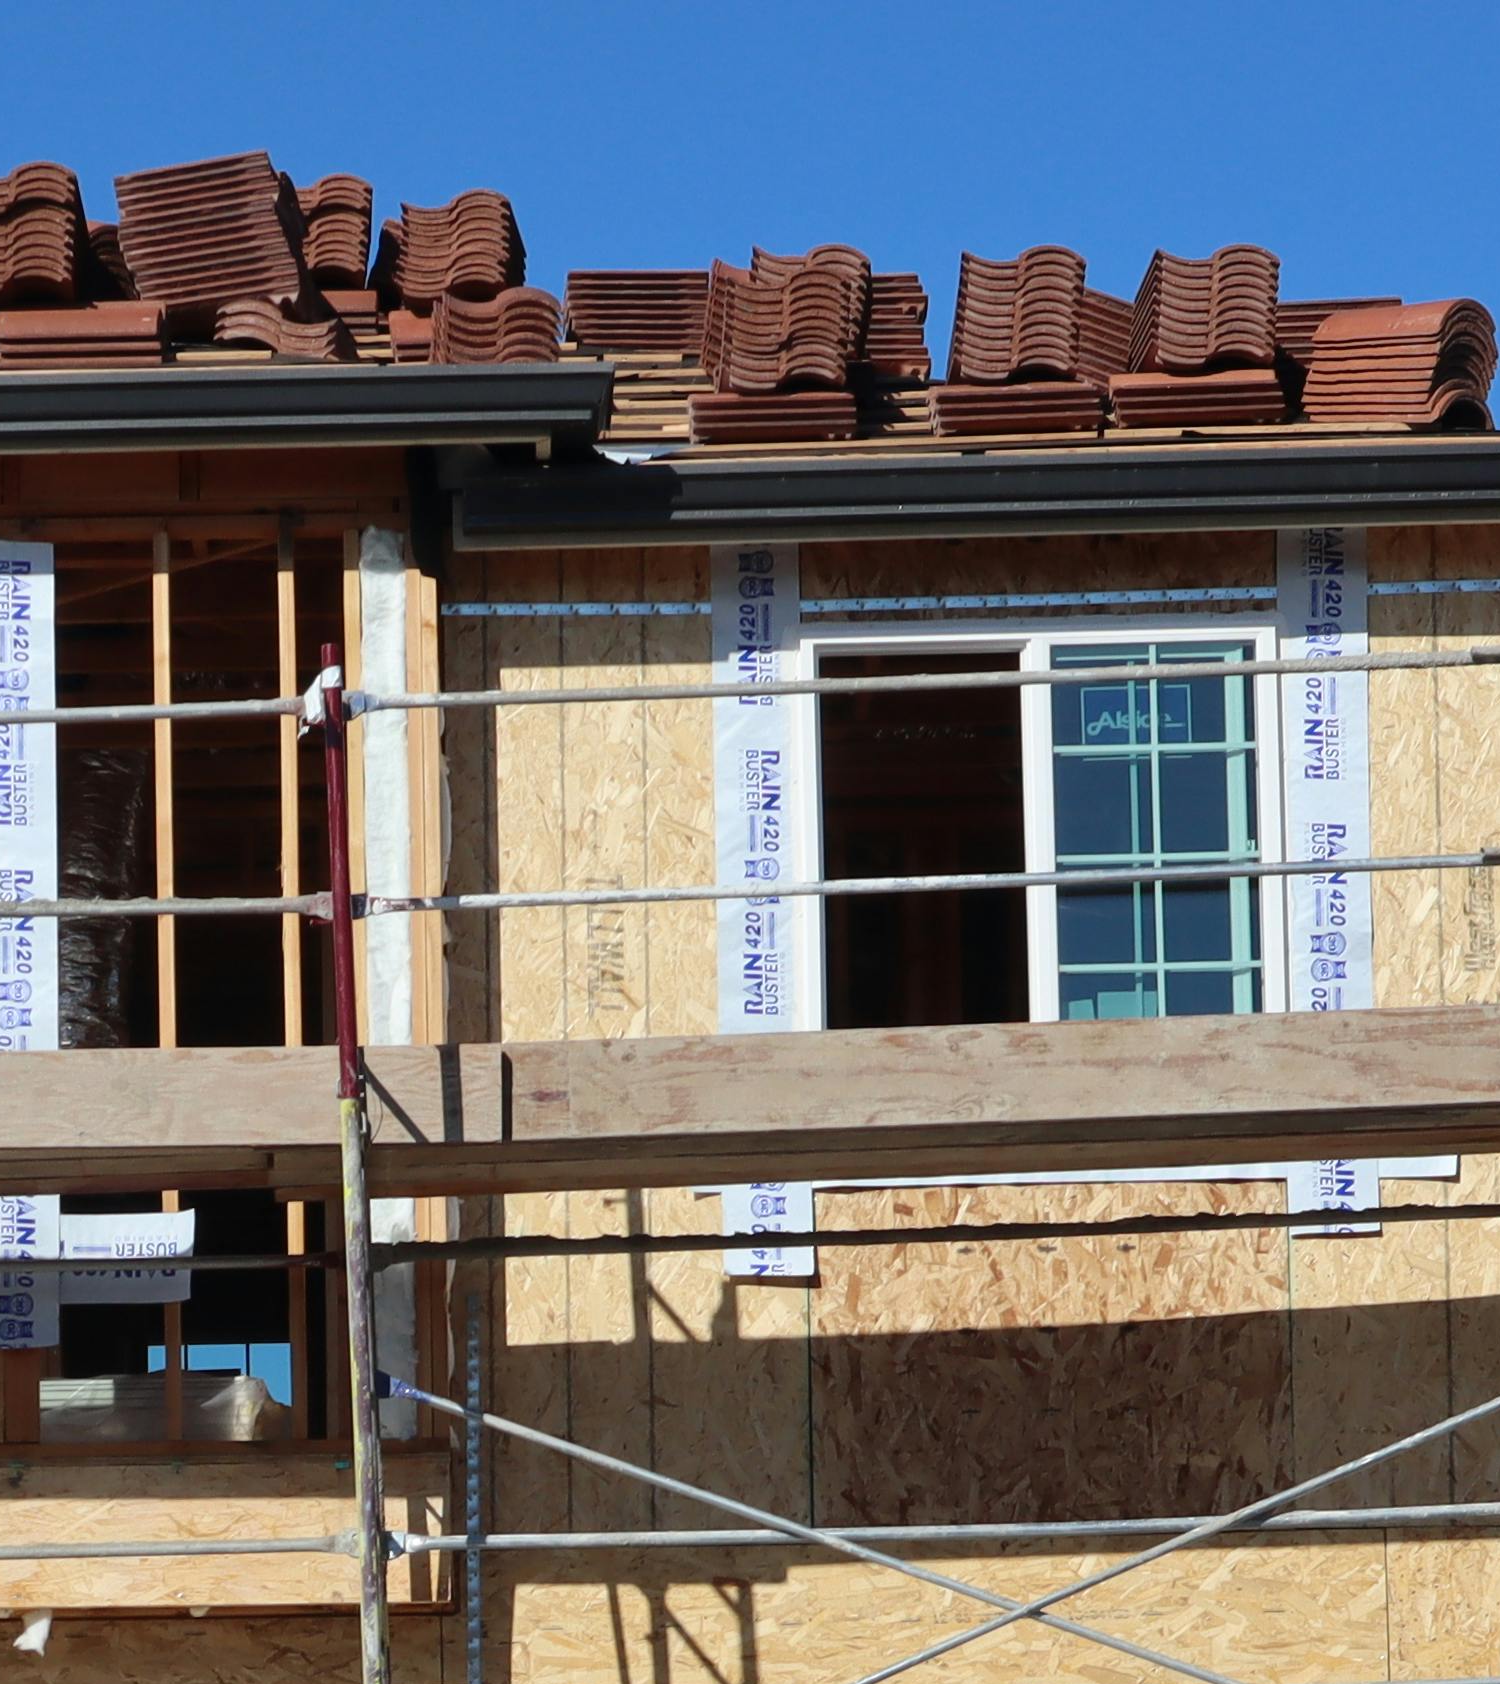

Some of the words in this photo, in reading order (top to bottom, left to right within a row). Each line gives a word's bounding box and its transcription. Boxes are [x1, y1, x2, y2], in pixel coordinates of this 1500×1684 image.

[1324, 528, 1344, 576] AIN
[11, 561, 30, 621] RAIN
[1325, 580, 1342, 618] 420
[13, 626, 29, 662] 420
[738, 604, 756, 641] 420
[759, 645, 773, 706] BSTER
[1305, 677, 1322, 714] 420
[1305, 718, 1324, 780] RAIN
[1325, 718, 1339, 781] BUSTER
[13, 764, 27, 826] BUSTER
[745, 750, 759, 811] BUSTER
[761, 751, 780, 811] RAIN
[763, 815, 779, 852] 420
[1311, 823, 1326, 885] BUSTR
[1327, 823, 1348, 884] RAN
[0, 869, 13, 932] BUSR
[15, 870, 34, 932] RAN
[1330, 889, 1347, 926] 420
[17, 936, 32, 974] 420
[745, 912, 761, 950] 420
[743, 953, 763, 1015] RAIN
[764, 953, 778, 1015] BUSTER
[1311, 987, 1328, 1012] 20
[1, 1197, 14, 1246] USTER
[16, 1197, 36, 1246] AIN
[18, 1251, 34, 1288] 40
[115, 1242, 178, 1258] BUSTER
